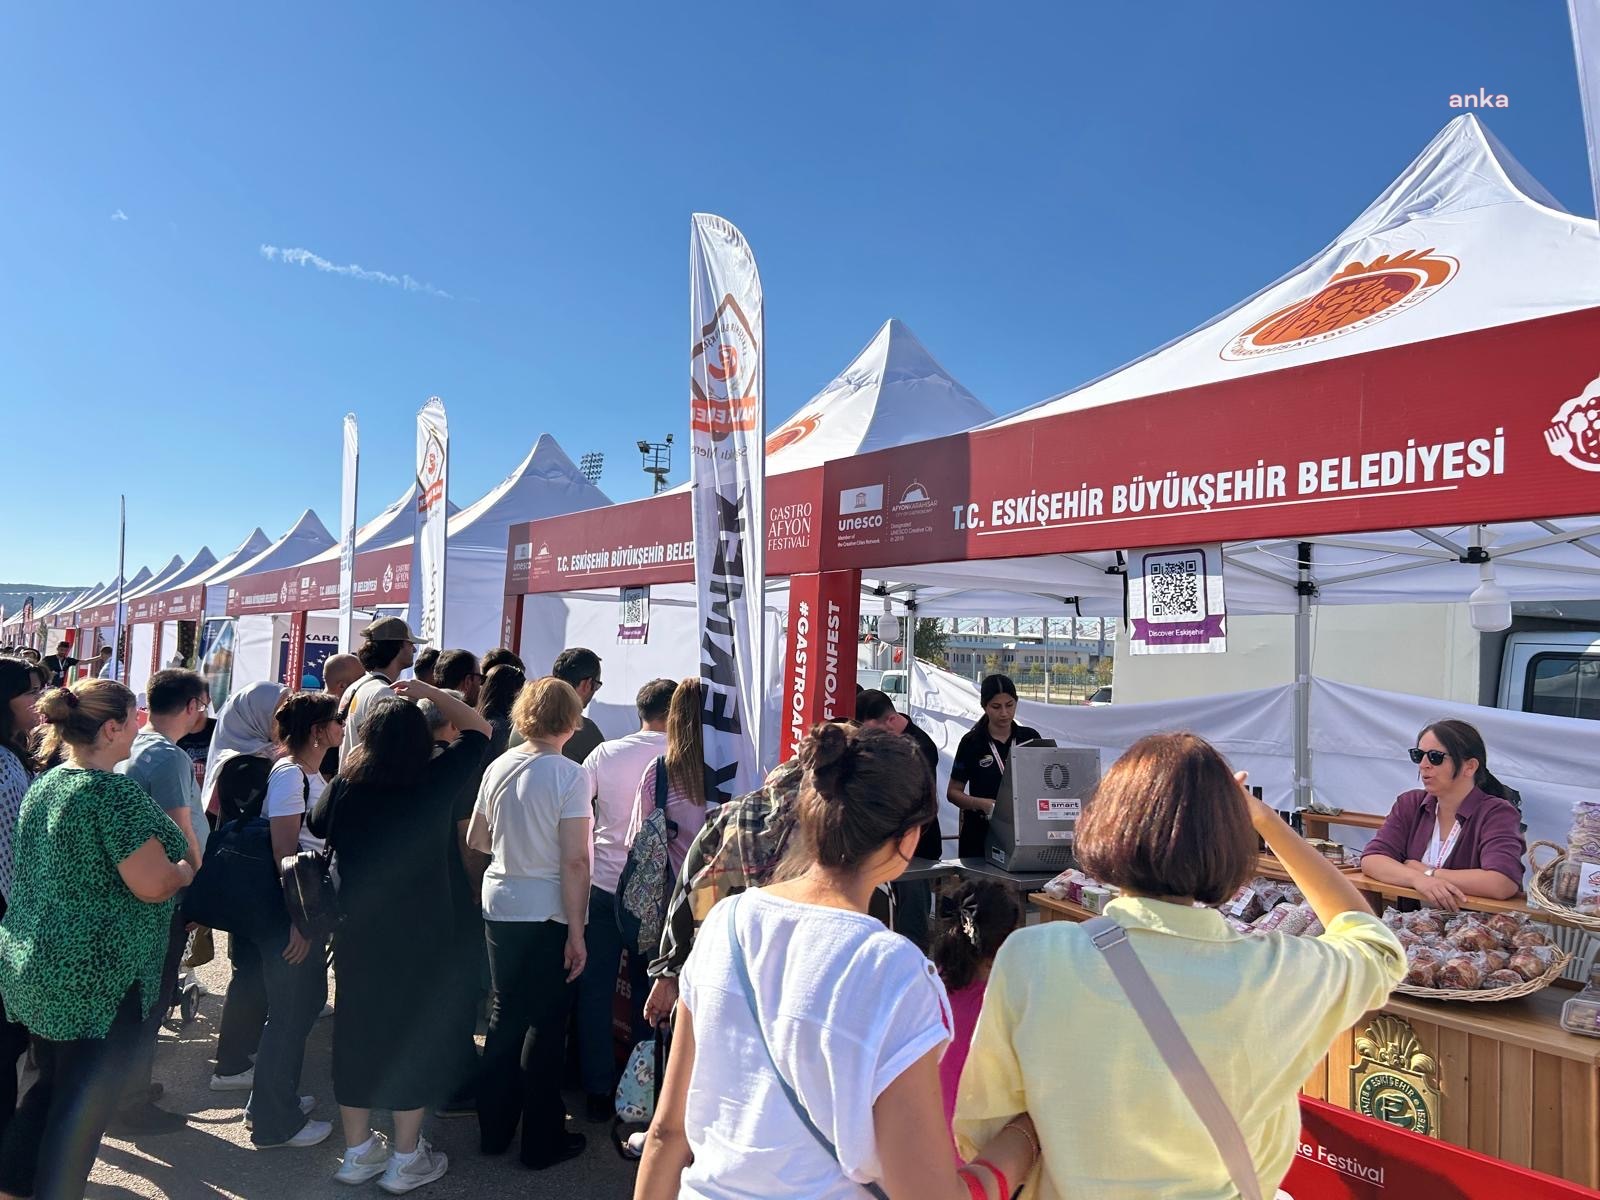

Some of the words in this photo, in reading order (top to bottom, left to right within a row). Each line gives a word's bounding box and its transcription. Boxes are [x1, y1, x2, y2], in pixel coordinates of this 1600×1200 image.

[953, 503, 985, 530] T.C.
[991, 482, 1103, 526] ESKİŞEHİR
[1112, 459, 1286, 514] BÜYÜKŞEHİR
[1298, 427, 1505, 495] BELEDİYESİ
[770, 502, 812, 521] GASTRO
[838, 514, 883, 532] unesco
[768, 517, 811, 537] AFYON
[557, 556, 569, 572] T.C.
[571, 549, 609, 574] ESKİŞEHİR
[611, 541, 664, 569] BÜYÜKŞEHİR
[666, 541, 695, 561] BELED
[281, 632, 339, 642] AKARA
[1175, 628, 1204, 637] Eskişehir
[823, 600, 841, 721] FYONFEST
[789, 600, 809, 760] #GASTROAFY
[1317, 1145, 1385, 1184] Festival
